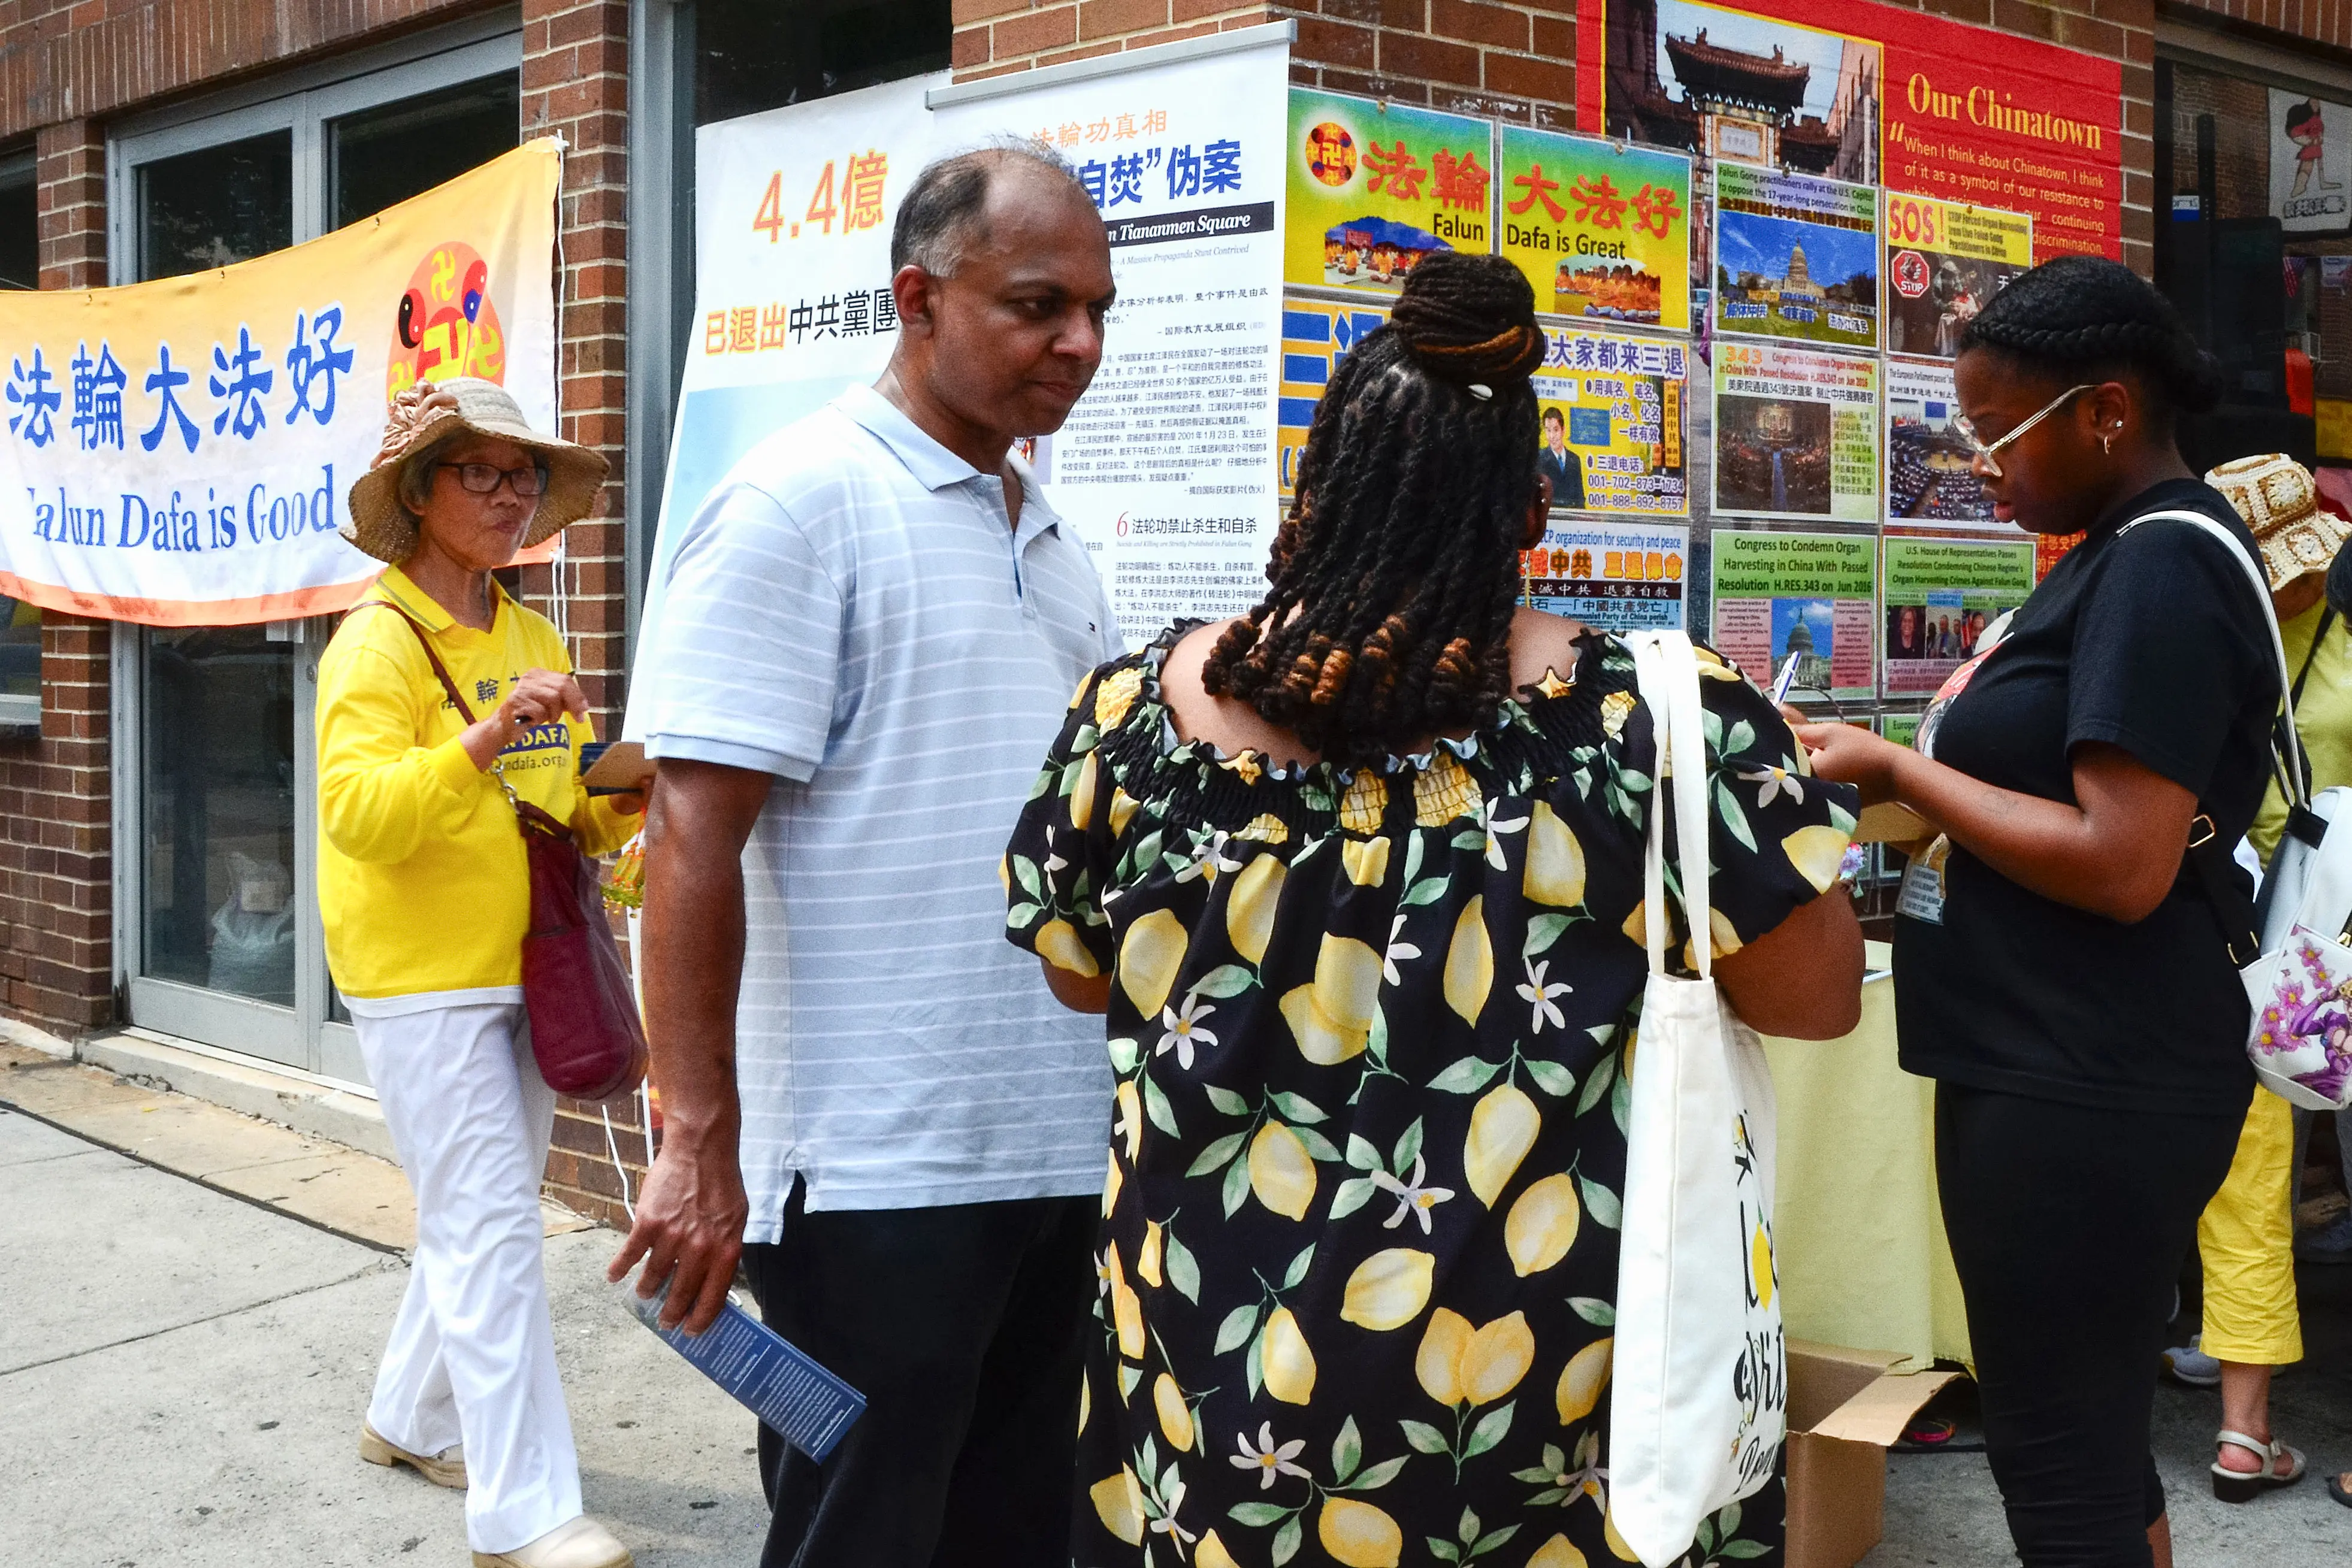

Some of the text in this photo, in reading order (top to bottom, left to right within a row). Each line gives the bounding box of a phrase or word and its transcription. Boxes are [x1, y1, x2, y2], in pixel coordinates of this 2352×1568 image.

[1907, 72, 2101, 150] Our Chinatown
[1033, 109, 1166, 149] 法輪功真相
[1362, 140, 1491, 213] 法輪
[1941, 144, 1945, 158] I
[1948, 144, 1975, 164] think
[1978, 152, 2010, 170] about
[2013, 158, 2069, 184] Chinatown,
[2073, 169, 2076, 183] I
[2079, 171, 2104, 188] think
[1719, 167, 1738, 178] Falun
[1739, 171, 1758, 183] Gong
[1760, 174, 1801, 189] practitioners
[1803, 181, 1817, 192] rally
[1827, 184, 1837, 195] the
[1904, 161, 2104, 211] of it as a symbol of our resistance to
[752, 149, 888, 244] 4.4億
[1508, 164, 1682, 240] 大法好
[1718, 183, 1728, 192] to
[1728, 186, 1753, 198] oppose
[1755, 187, 1766, 198] the
[1768, 190, 1810, 206] 17-year-long
[1811, 197, 1848, 212] persecution
[1849, 203, 1856, 211] in
[1119, 214, 1251, 241] Tiananmen Square
[1433, 213, 1485, 243] Falun
[2052, 213, 2105, 236] continuing
[1127, 255, 1151, 265] Massive
[1154, 249, 1193, 263] Propaganda
[1195, 247, 1212, 258] Stunt
[1213, 244, 1249, 255] Contrived
[1507, 223, 1627, 260] Dafa is Great
[2033, 231, 2105, 255] discrimination.
[1544, 335, 1683, 376] 大家都来三退
[1726, 346, 1763, 364] 343
[5, 307, 355, 453] 法輪大法好
[1588, 475, 1684, 491] 001-702-873-1734
[28, 464, 337, 552] alun Dafa is Good
[1588, 494, 1683, 509] 001-888-892-8757
[1116, 511, 1129, 537] 6
[1132, 517, 1257, 534] 法轮功禁止杀生和自杀
[1540, 529, 1681, 550] CP organization for security and peace
[1735, 538, 1861, 556] Congress to Condemn Organ
[1906, 546, 2017, 559] U.S. House of Representatives Passes
[1724, 559, 1869, 573] Harvesting in China With Passed
[1897, 561, 2024, 574] Resolution Condemning Chinese Regime's
[1718, 579, 1872, 593] Resolution H.RES.343 on Jun 2016
[1893, 574, 1913, 585] Organ
[1915, 575, 1948, 587] Harvesting
[1950, 576, 1970, 585] Crimes
[1972, 576, 1994, 588] Against
[1602, 612, 1619, 620] Party
